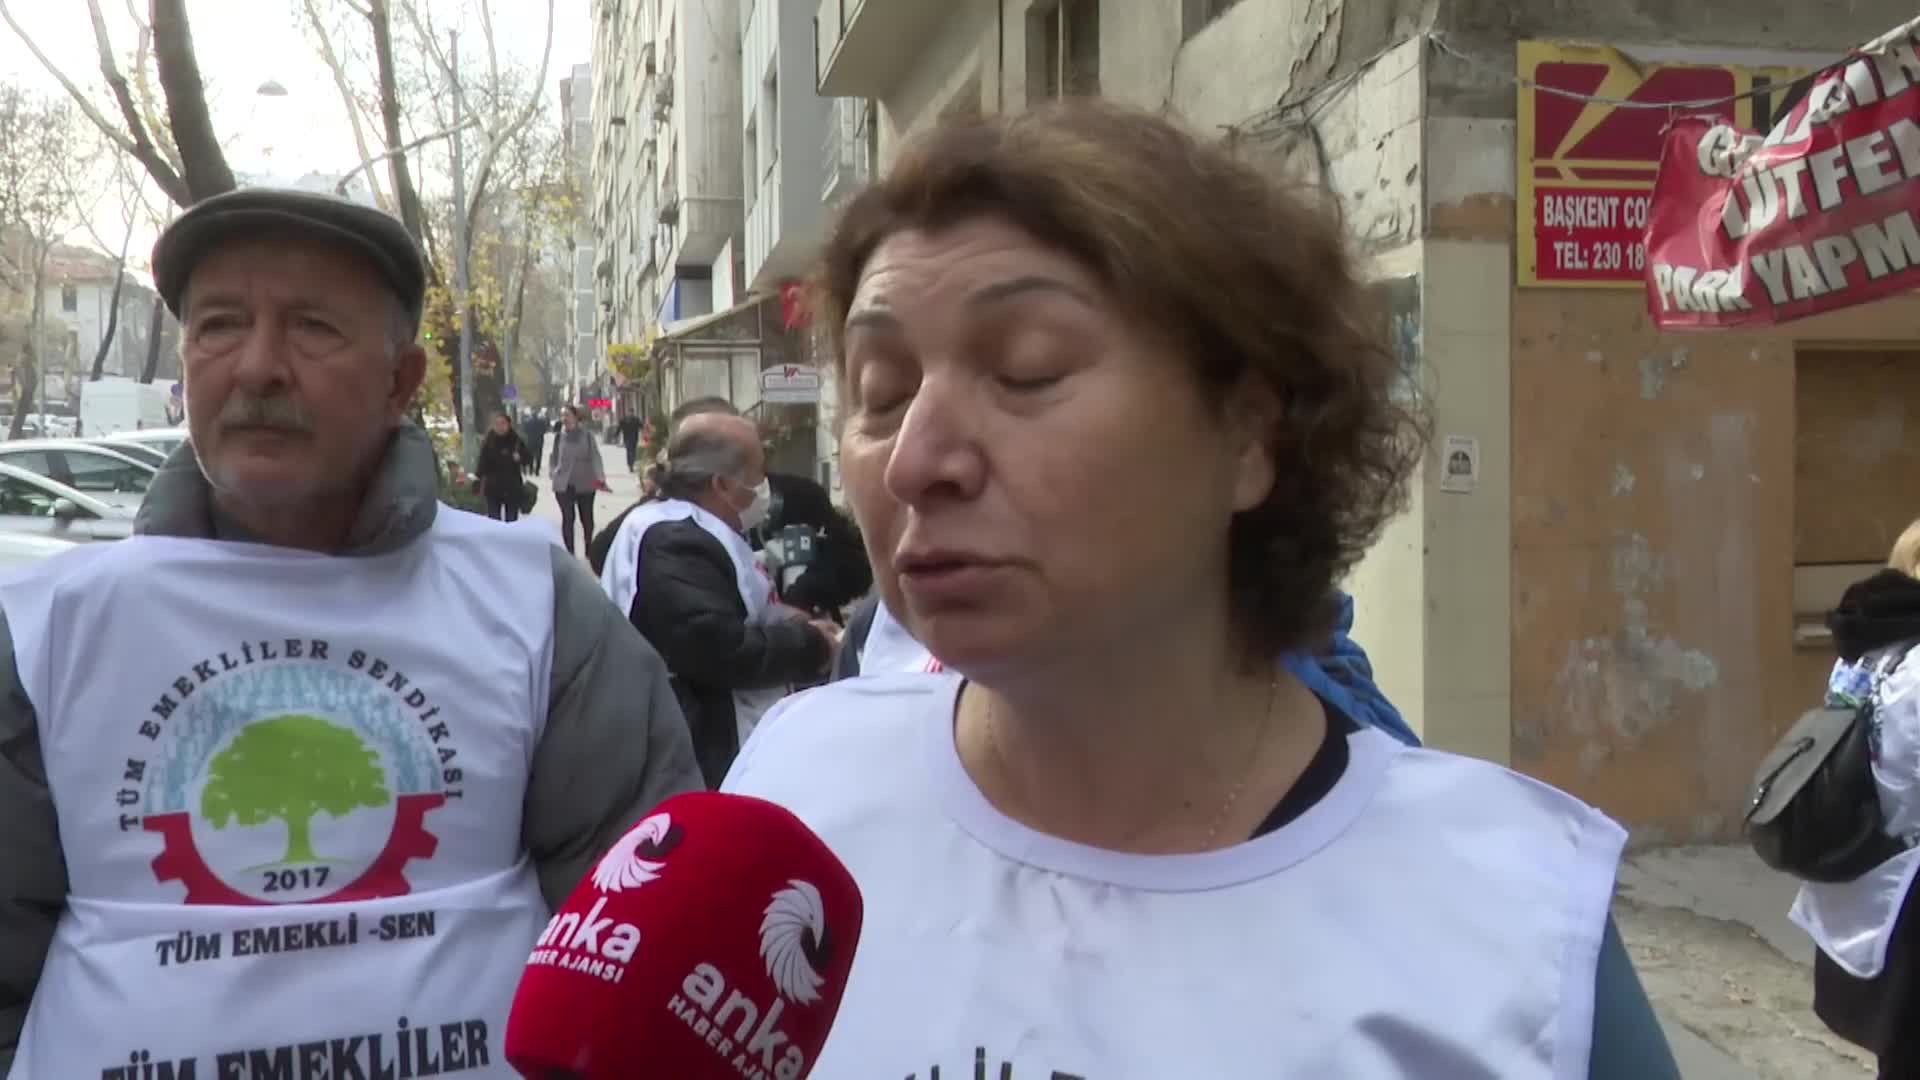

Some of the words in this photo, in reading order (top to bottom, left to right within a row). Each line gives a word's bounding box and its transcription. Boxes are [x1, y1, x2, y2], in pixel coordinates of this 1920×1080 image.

[1543, 195, 1619, 235] BAŞKENT
[1623, 197, 1651, 229] CO
[1553, 241, 1588, 270] TEL:
[1593, 242, 1621, 270] 230
[117, 758, 146, 831] TÜM
[138, 639, 329, 741] EMEKLİLER
[347, 649, 463, 800] SENDİKASI
[263, 866, 330, 892] 2017
[156, 931, 221, 966] TÜM
[231, 912, 358, 956] EMEKLİ
[559, 952, 625, 984] AJANSI
[215, 1016, 490, 1080] EMEKLİLER
[666, 994, 733, 1057] HABER
